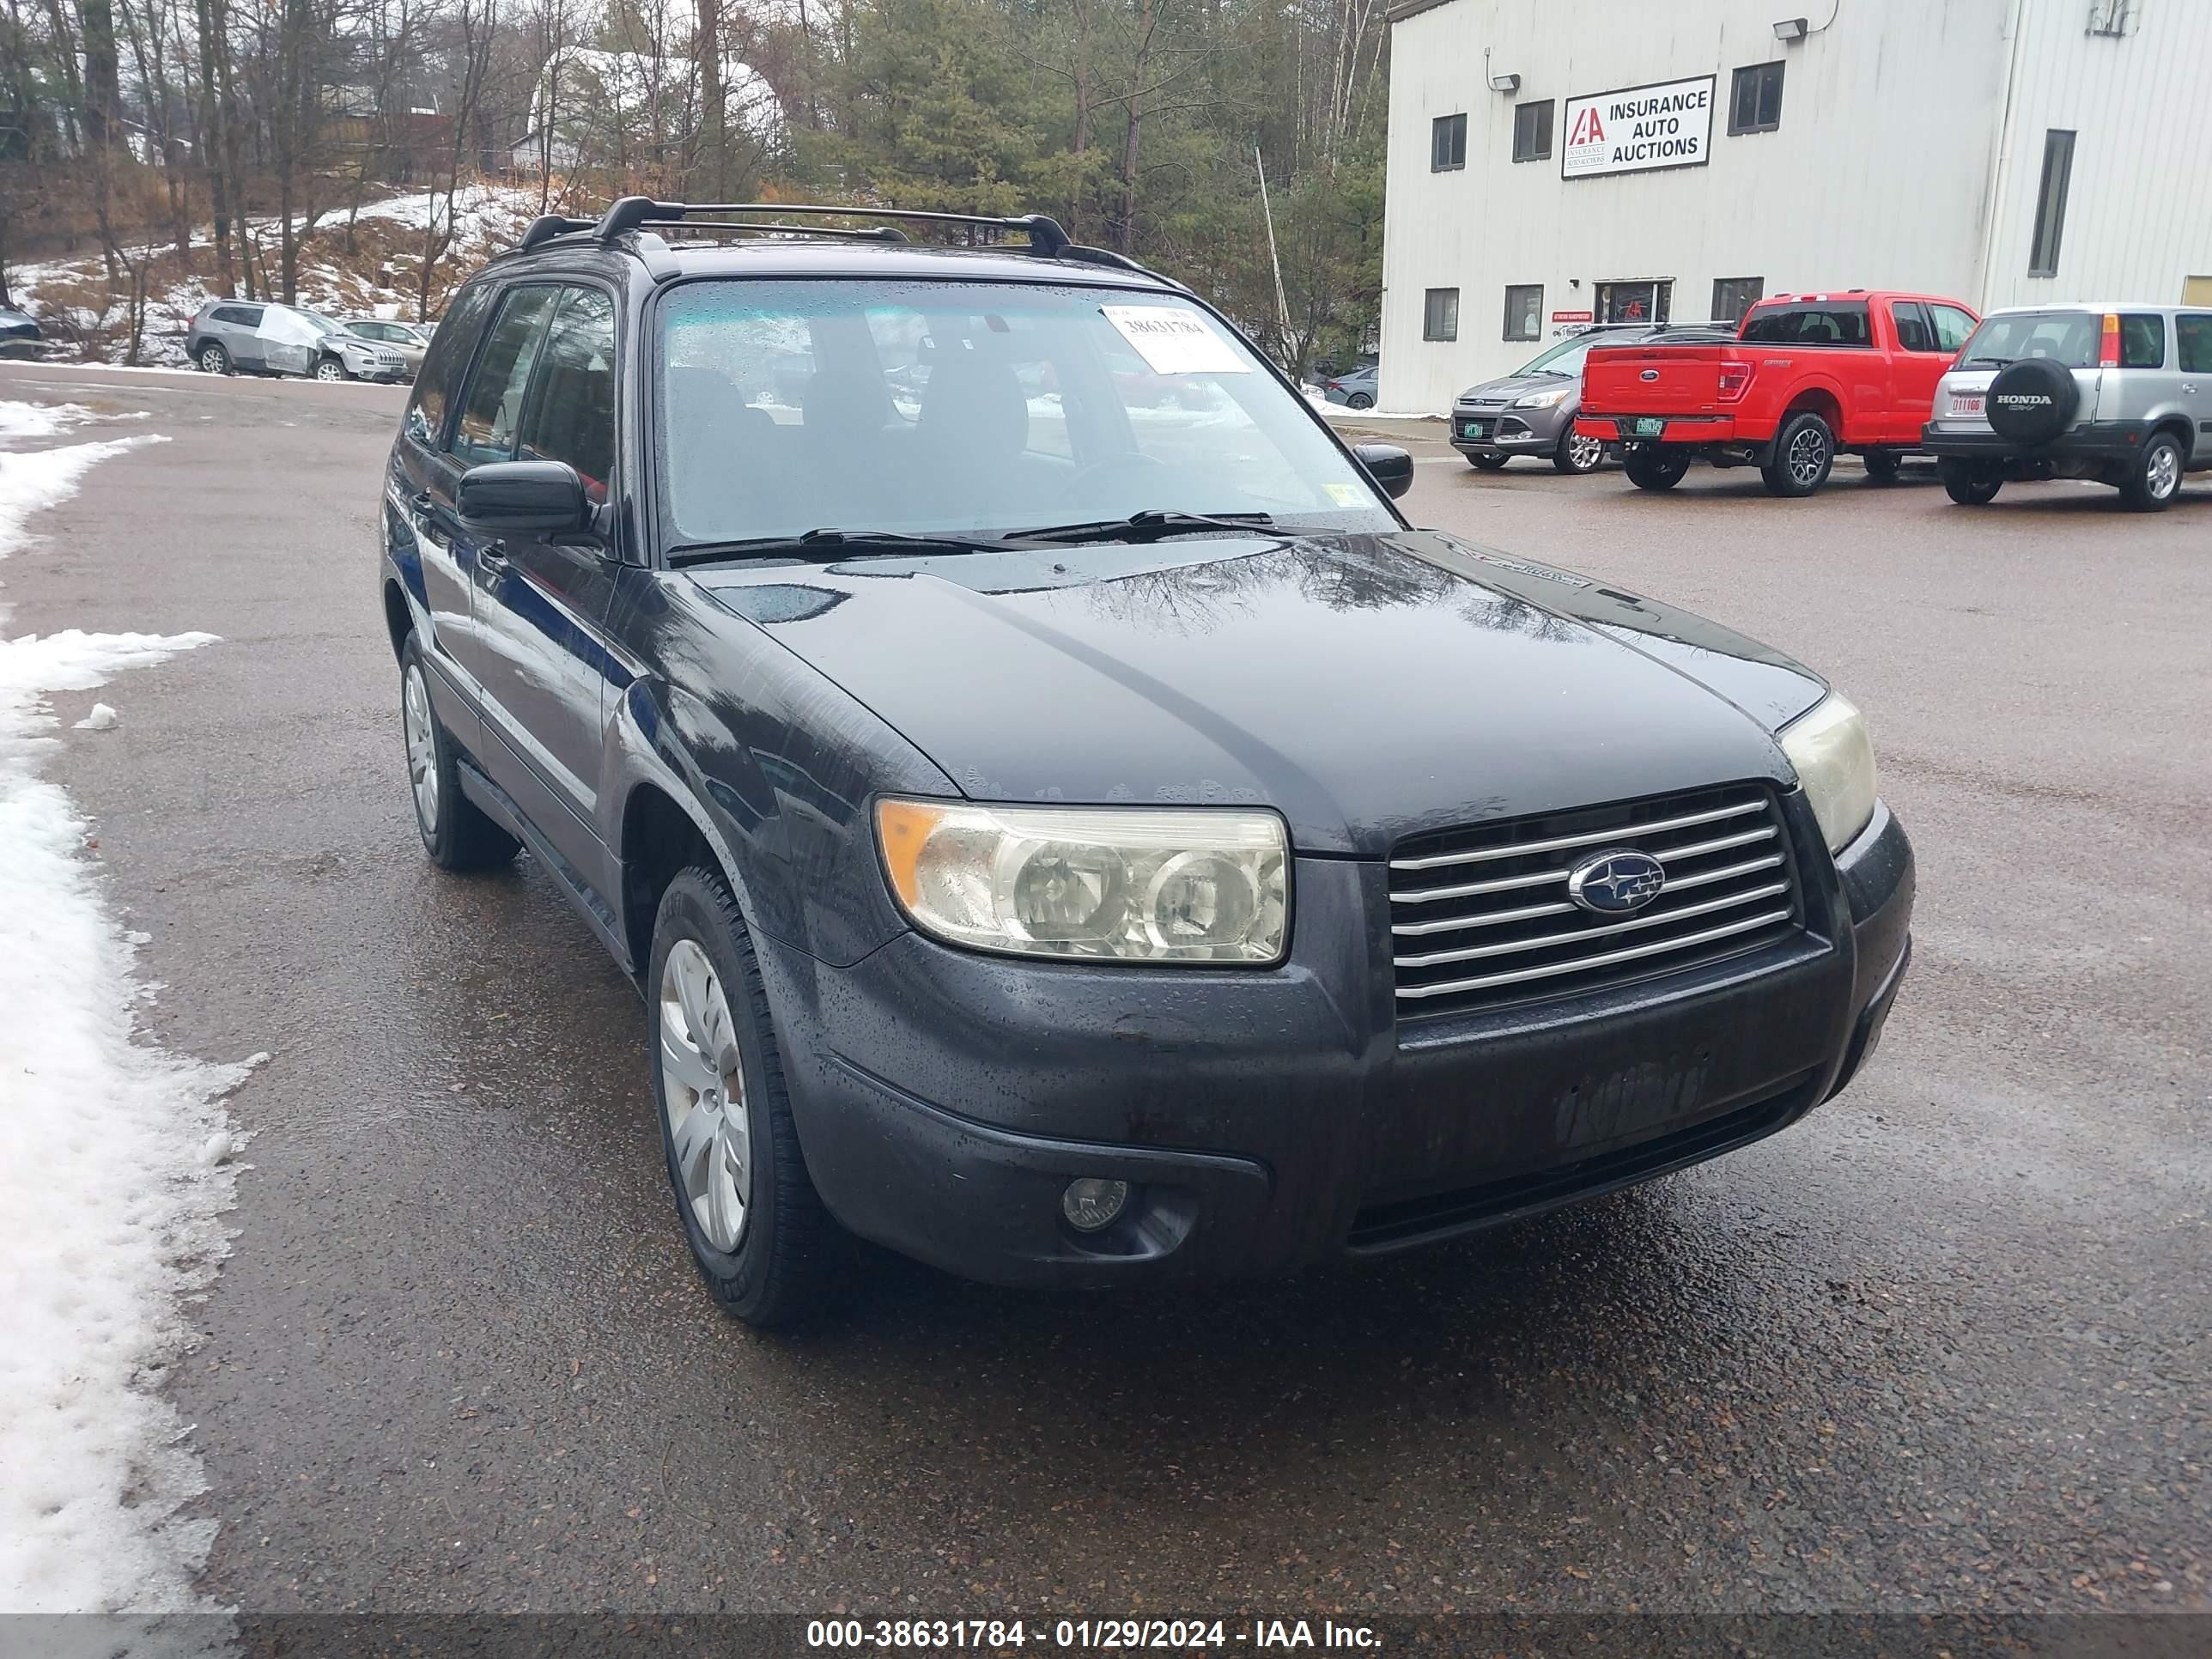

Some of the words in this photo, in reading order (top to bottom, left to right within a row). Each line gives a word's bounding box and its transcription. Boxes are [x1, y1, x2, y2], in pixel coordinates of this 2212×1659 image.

[1609, 90, 1708, 121] INSURANCE
[1632, 117, 1680, 140] AUTO
[1611, 137, 1698, 163] AUCTIONS
[1123, 320, 1205, 335] 38631784
[1996, 395, 2053, 404] HONDA
